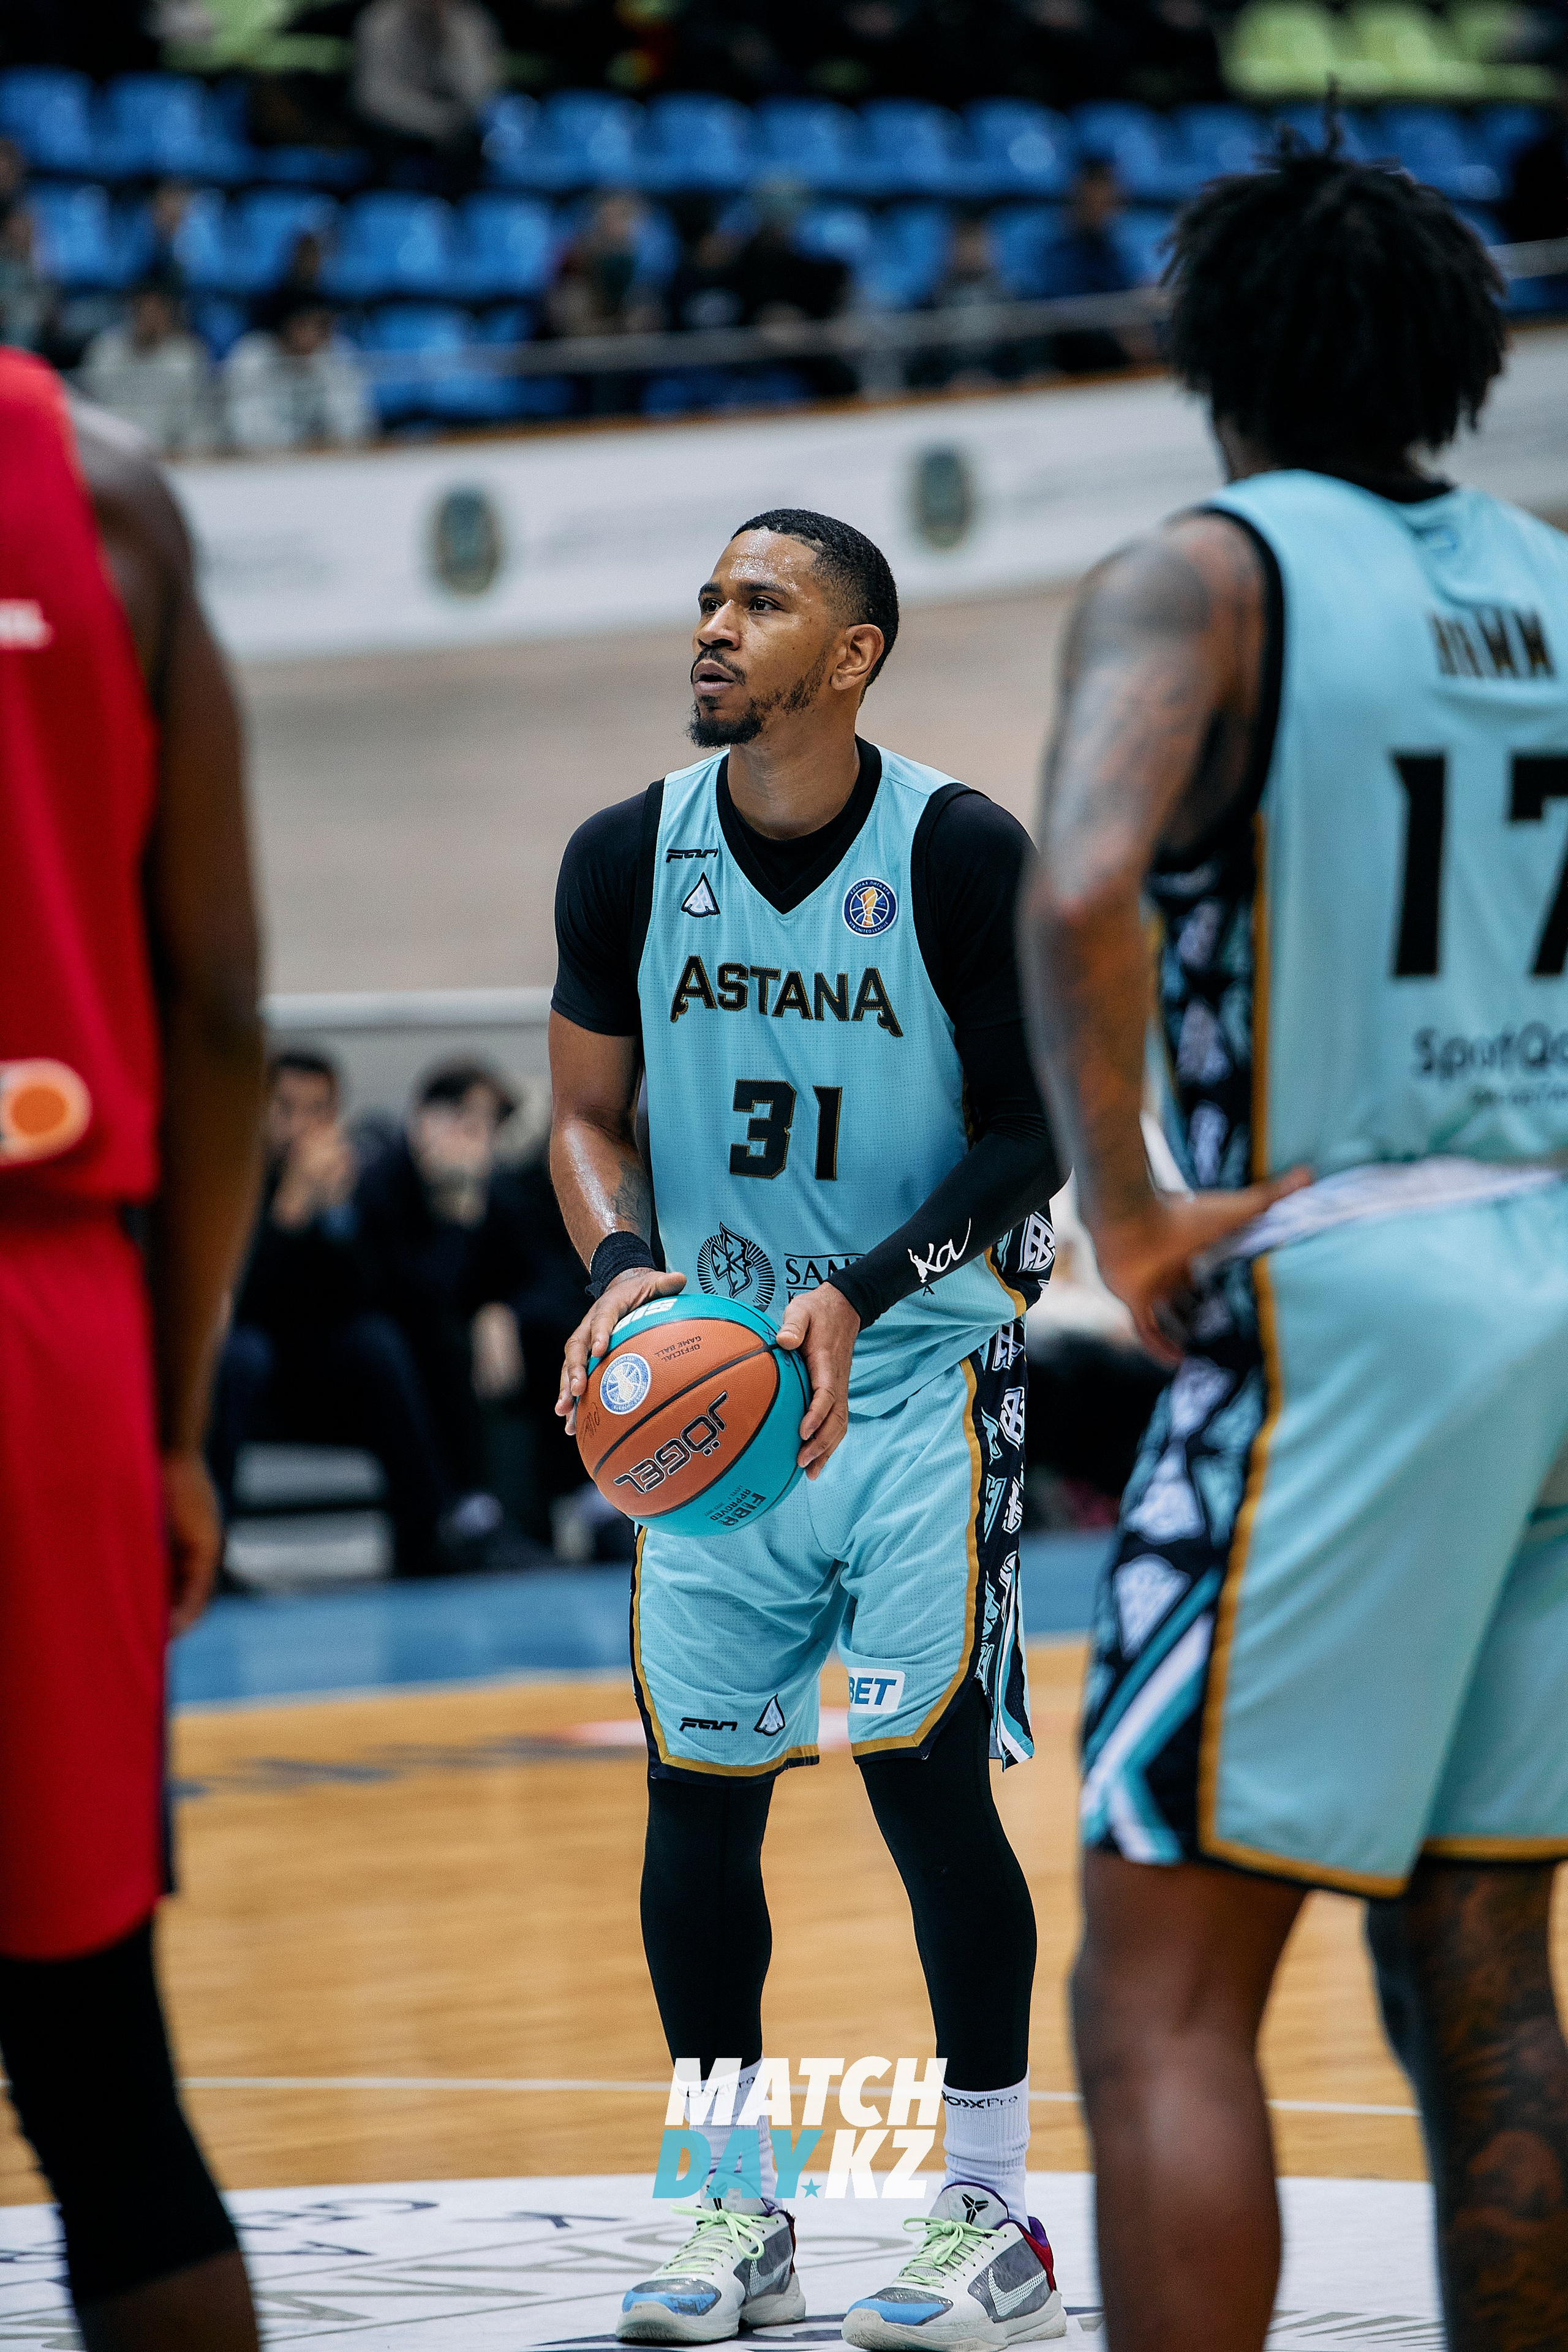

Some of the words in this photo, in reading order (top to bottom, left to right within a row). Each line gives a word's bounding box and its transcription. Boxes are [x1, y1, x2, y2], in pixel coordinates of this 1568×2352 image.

[1389, 750, 1568, 976] 17
[670, 955, 903, 1037] ASTANA
[729, 1079, 843, 1181] 31
[654, 1344, 677, 1358] BALL
[662, 1343, 701, 1362] OFFICIAL
[677, 1335, 703, 1348] GAME
[613, 1390, 728, 1494] JÖGEL
[709, 1488, 752, 1521] APPROVED
[717, 1492, 767, 1526] FIBA
